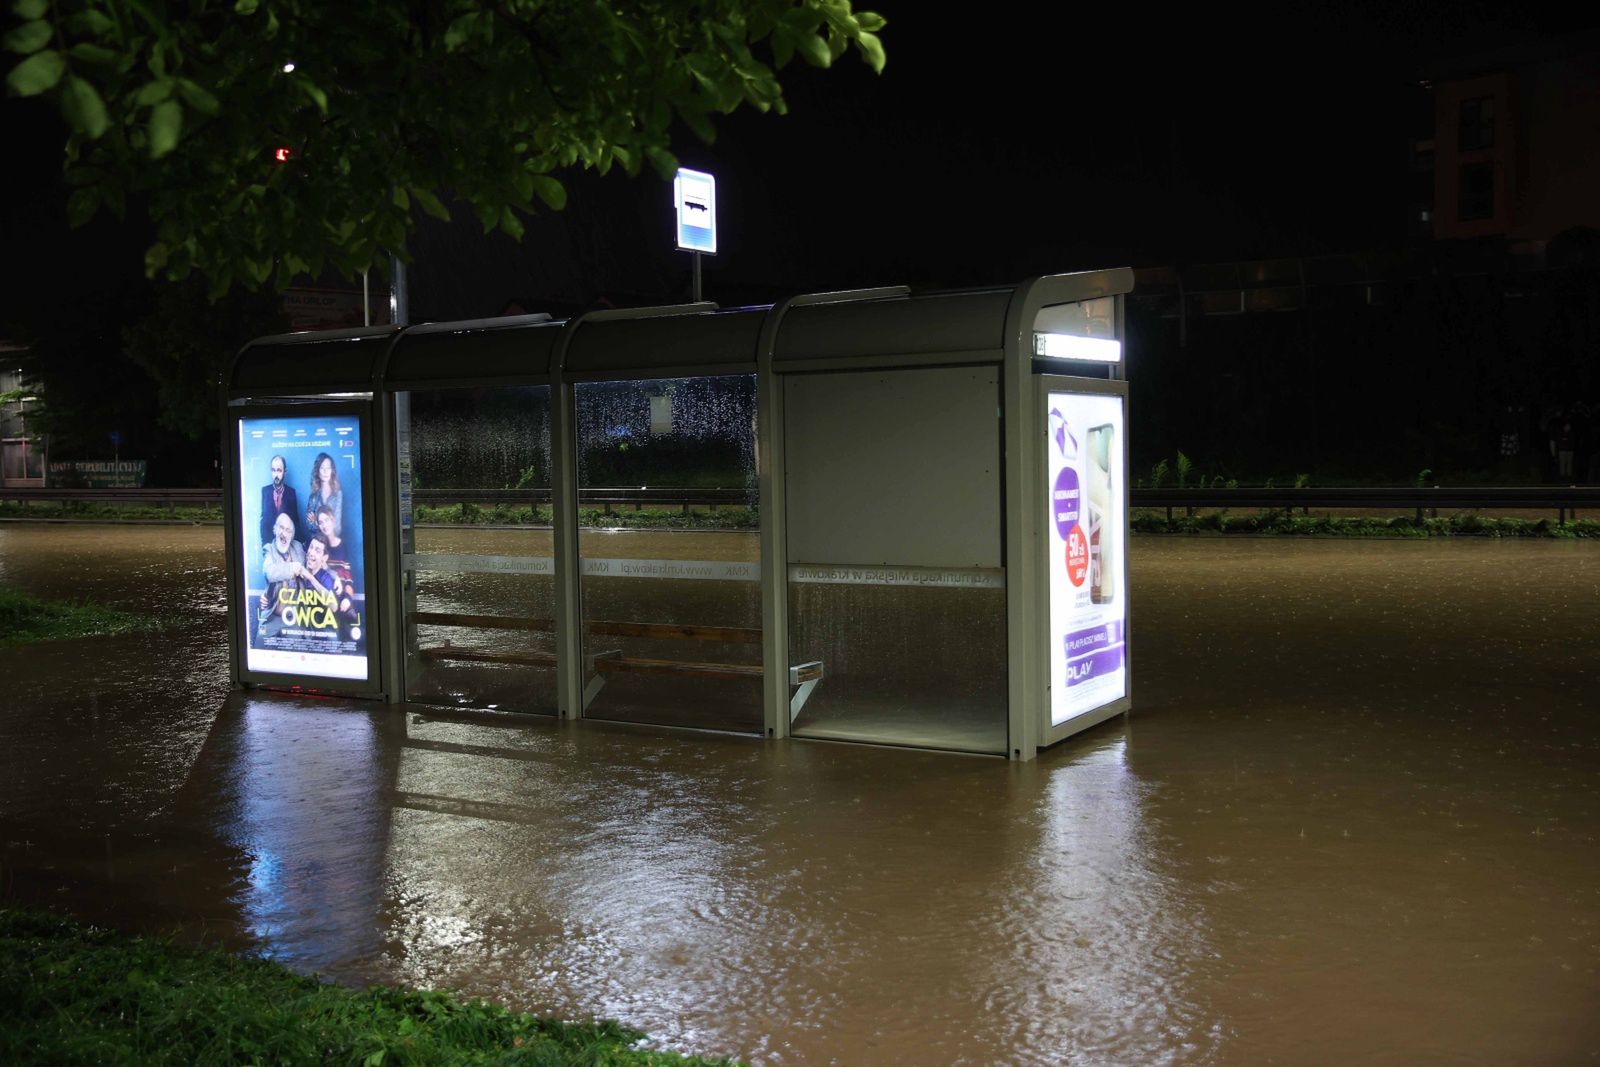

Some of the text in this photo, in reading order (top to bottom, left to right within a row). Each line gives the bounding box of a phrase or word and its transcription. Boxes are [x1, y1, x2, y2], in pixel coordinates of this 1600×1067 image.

[278, 588, 338, 606] CZARNA
[282, 606, 338, 629] OWCA
[1067, 660, 1093, 680] PLAY
